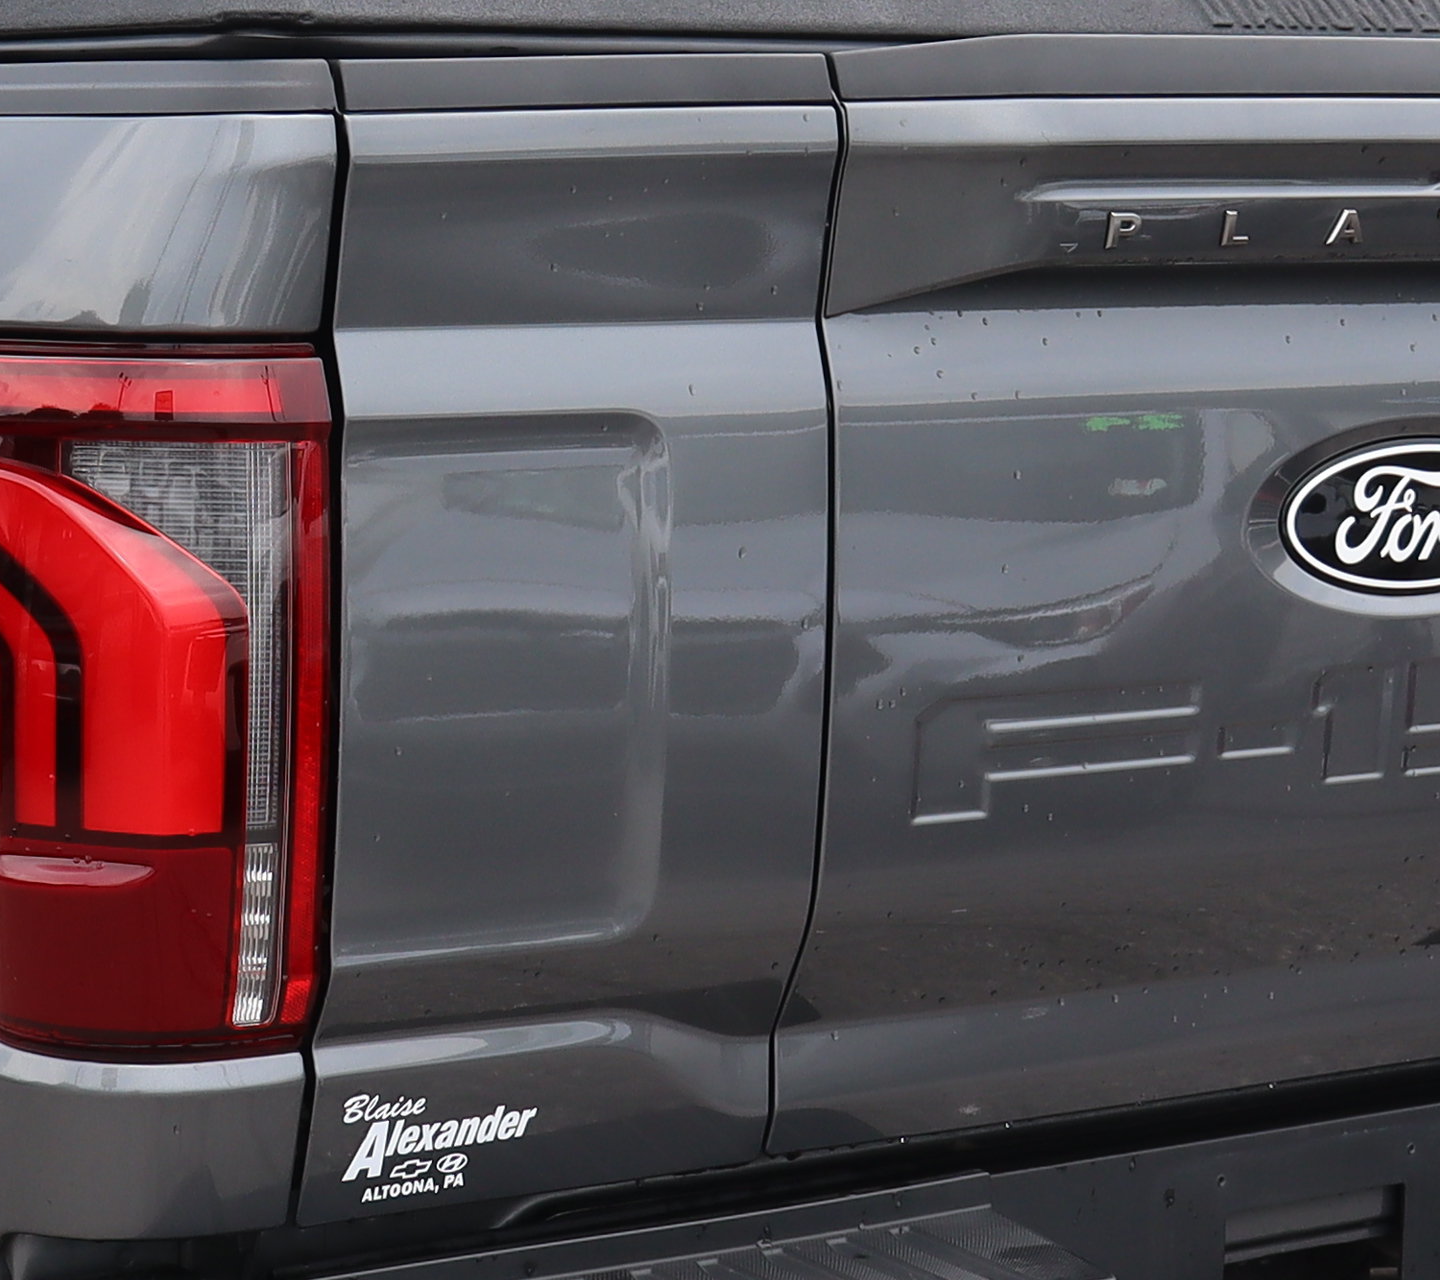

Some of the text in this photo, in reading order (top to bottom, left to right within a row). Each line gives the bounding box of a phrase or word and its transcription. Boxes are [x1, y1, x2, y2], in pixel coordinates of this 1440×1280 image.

[343, 1093, 426, 1124] Blaise
[341, 1104, 538, 1182] Alexander
[361, 1172, 465, 1203] ALTOONA, PA
